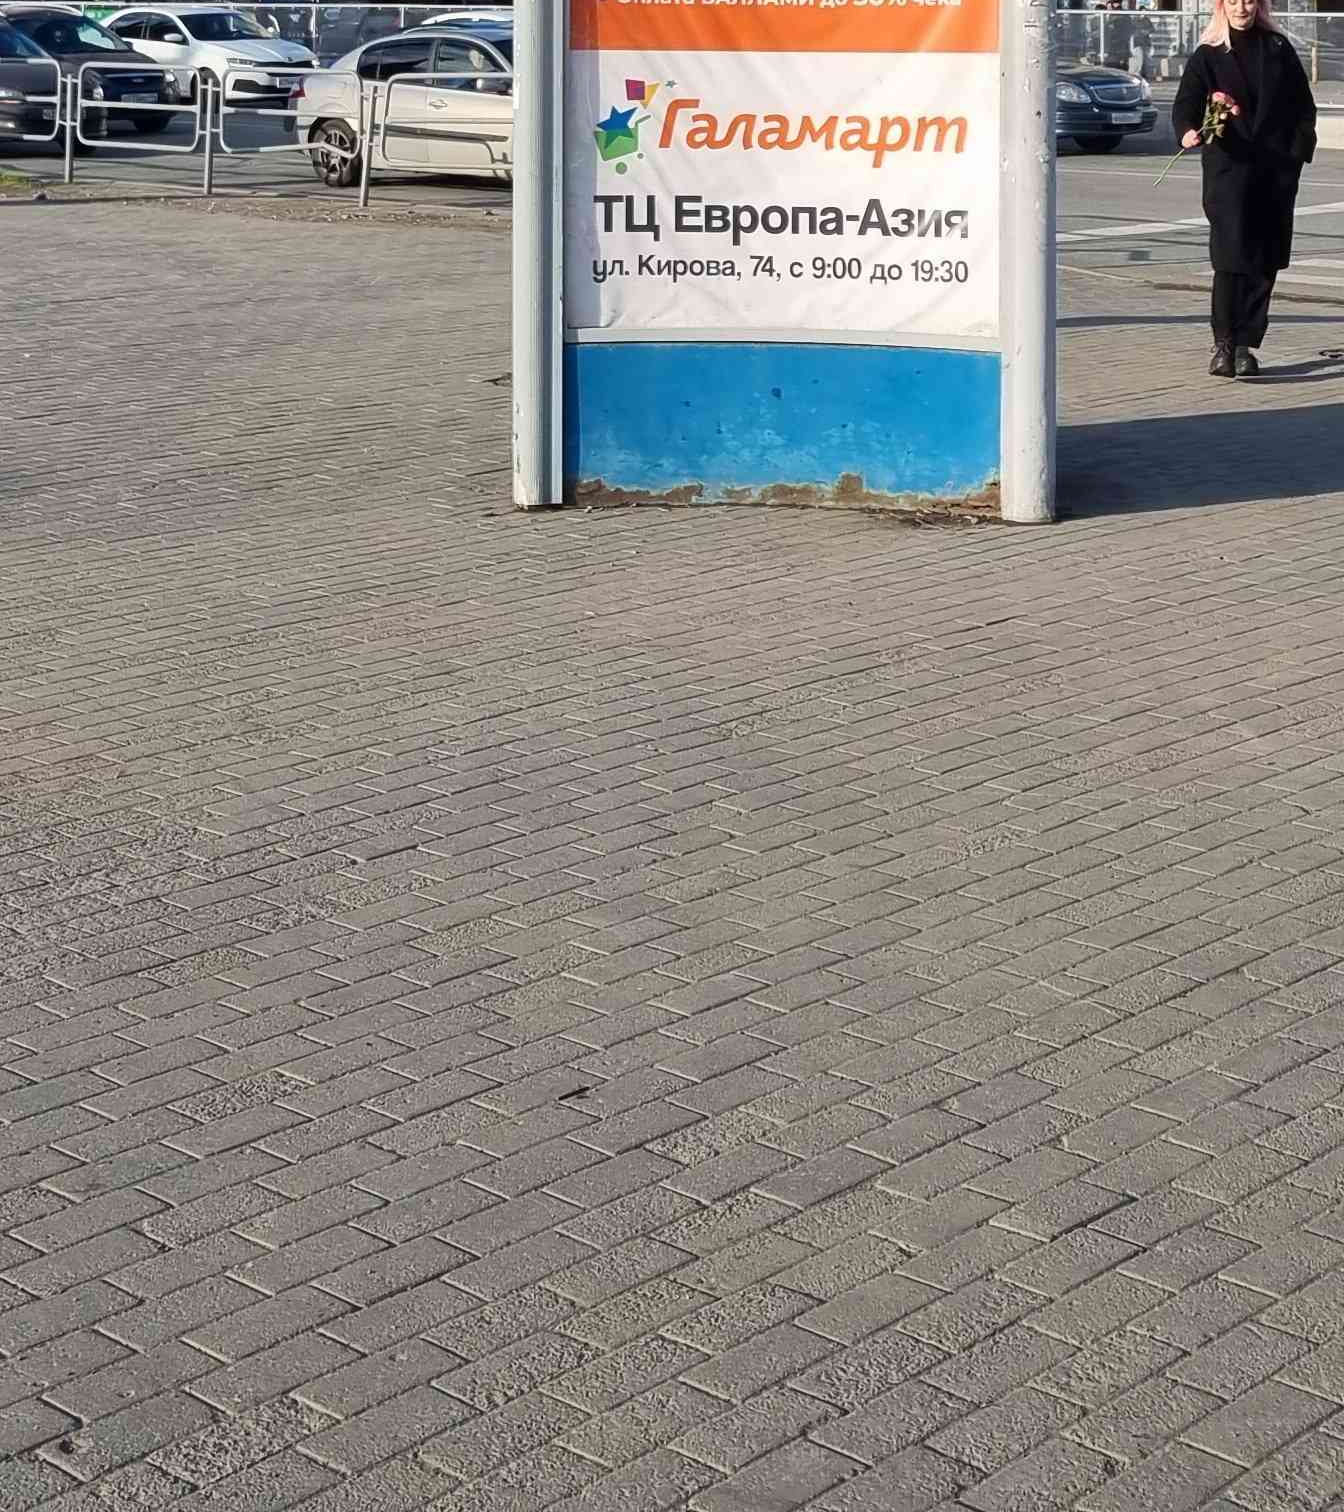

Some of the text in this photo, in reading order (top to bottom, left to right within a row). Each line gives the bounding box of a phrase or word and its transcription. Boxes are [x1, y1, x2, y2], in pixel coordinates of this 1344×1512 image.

[658, 98, 968, 168] Галамарт
[593, 195, 969, 246] ТЦ Европа-Азия
[592, 255, 969, 285] ул. Кирова, 74, с 9:00 до 19:30
